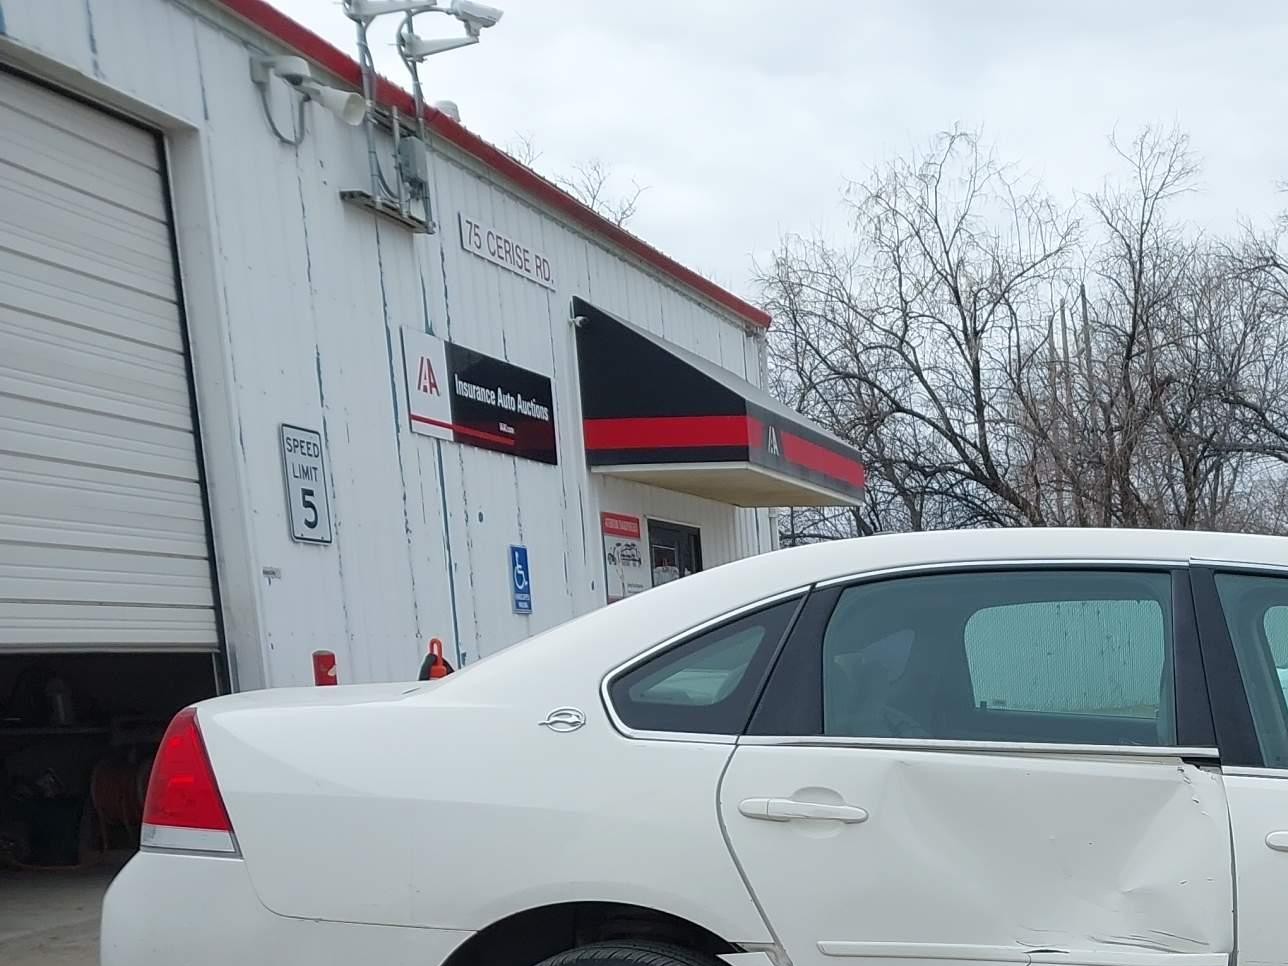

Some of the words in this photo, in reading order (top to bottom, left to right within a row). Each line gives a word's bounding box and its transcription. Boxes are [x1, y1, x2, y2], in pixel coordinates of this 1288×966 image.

[465, 219, 482, 250] 75
[486, 230, 531, 273] CERISE
[534, 254, 554, 284] RD.
[454, 373, 496, 405] Insurance
[497, 387, 516, 412] Auto
[517, 393, 549, 421] Auctions
[285, 436, 320, 458] SPEED
[292, 463, 318, 482] LIMIT
[301, 487, 319, 529] 5
